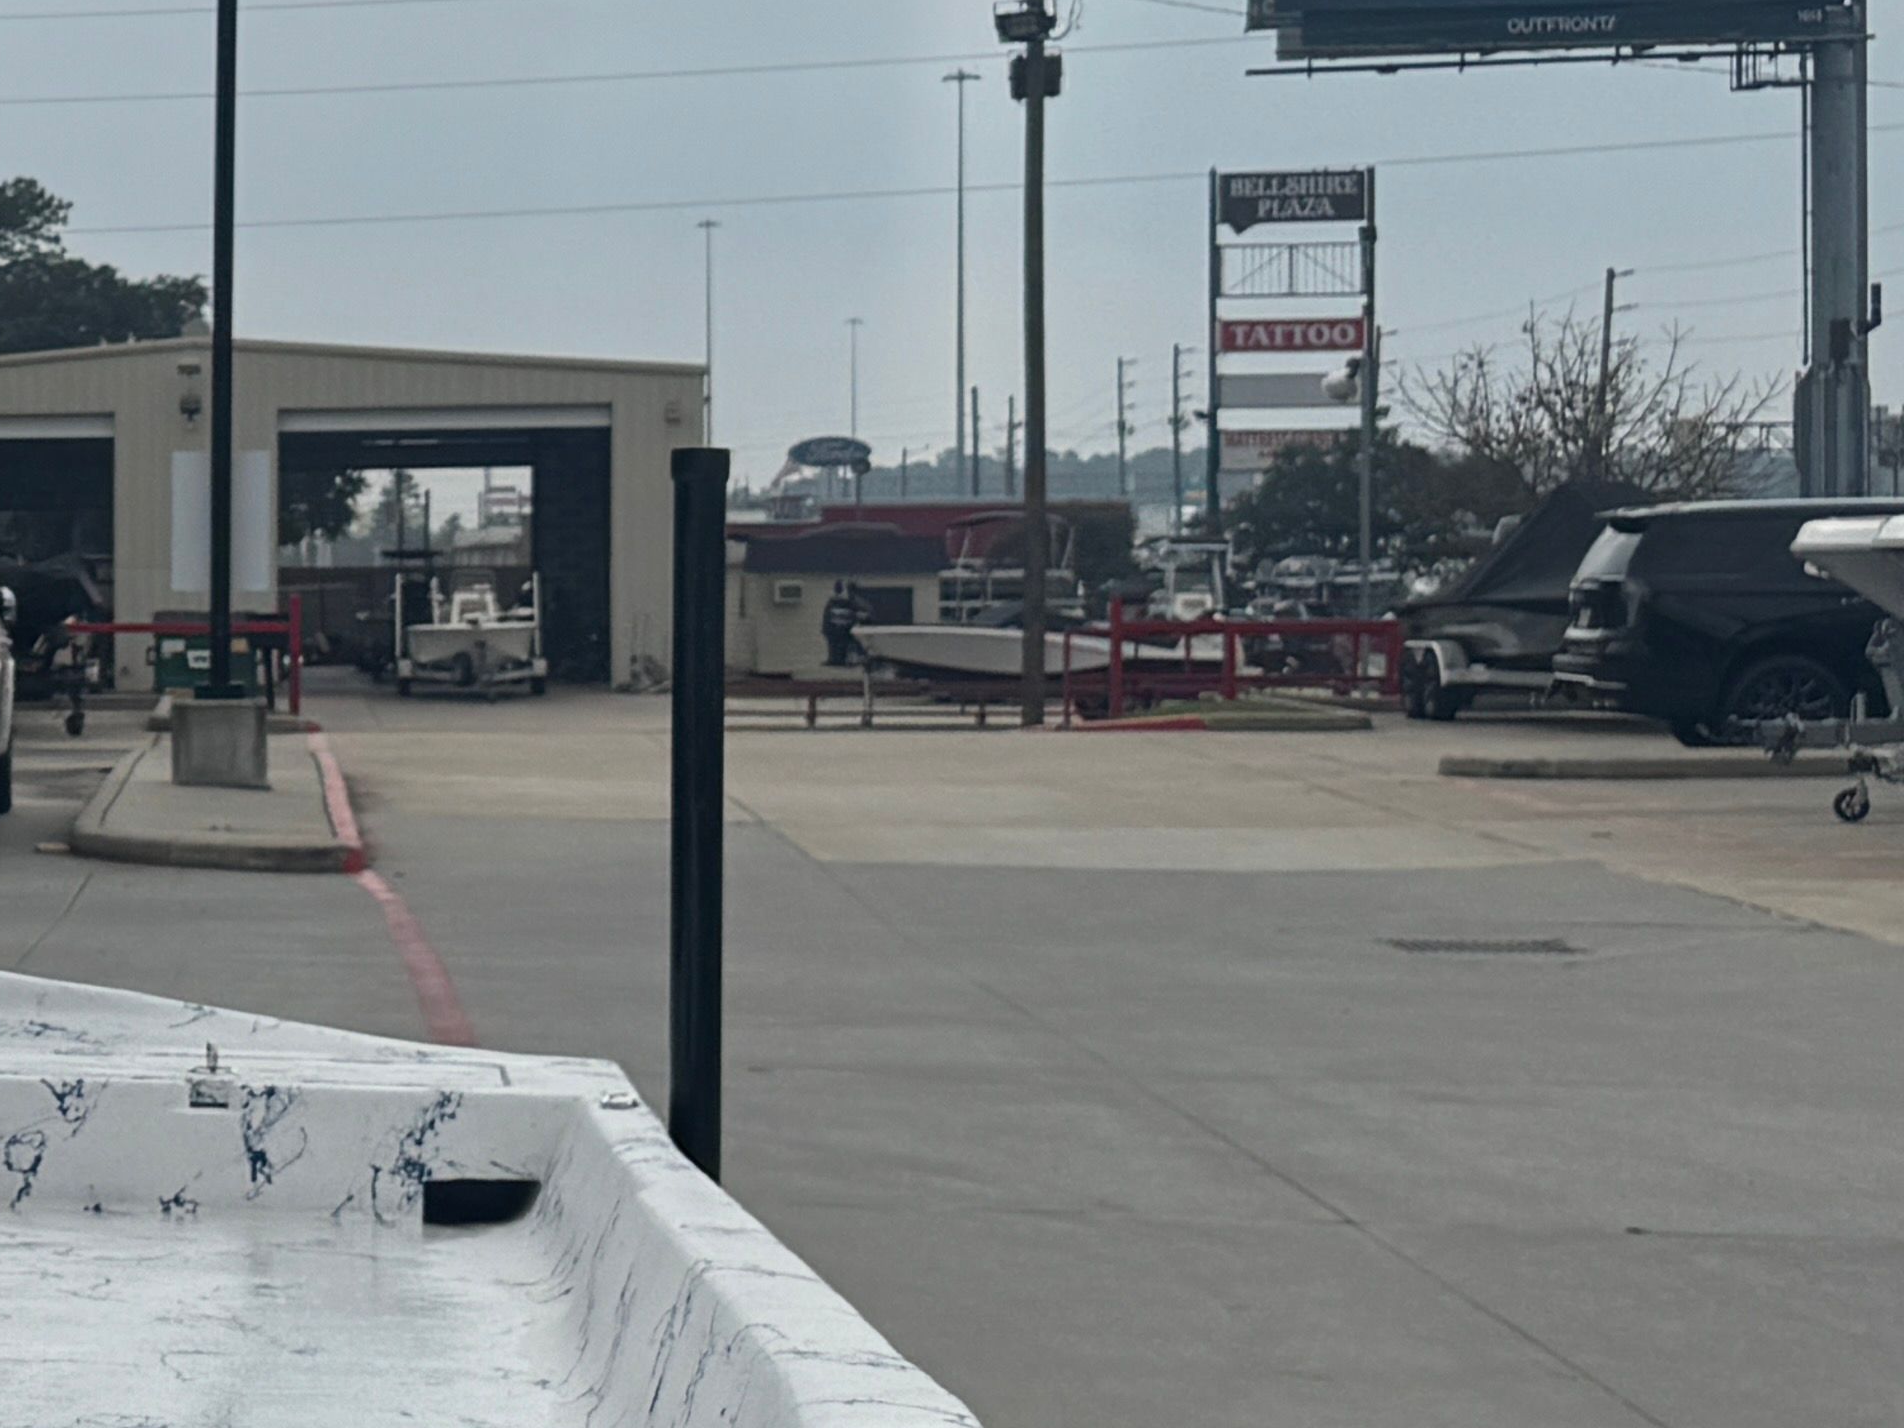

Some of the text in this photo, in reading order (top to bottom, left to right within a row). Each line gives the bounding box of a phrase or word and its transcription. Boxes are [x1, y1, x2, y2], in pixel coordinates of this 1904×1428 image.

[1229, 174, 1358, 197] BELLSHIRE
[1256, 196, 1335, 219] PLAZA
[1228, 322, 1356, 348] TATTOO
